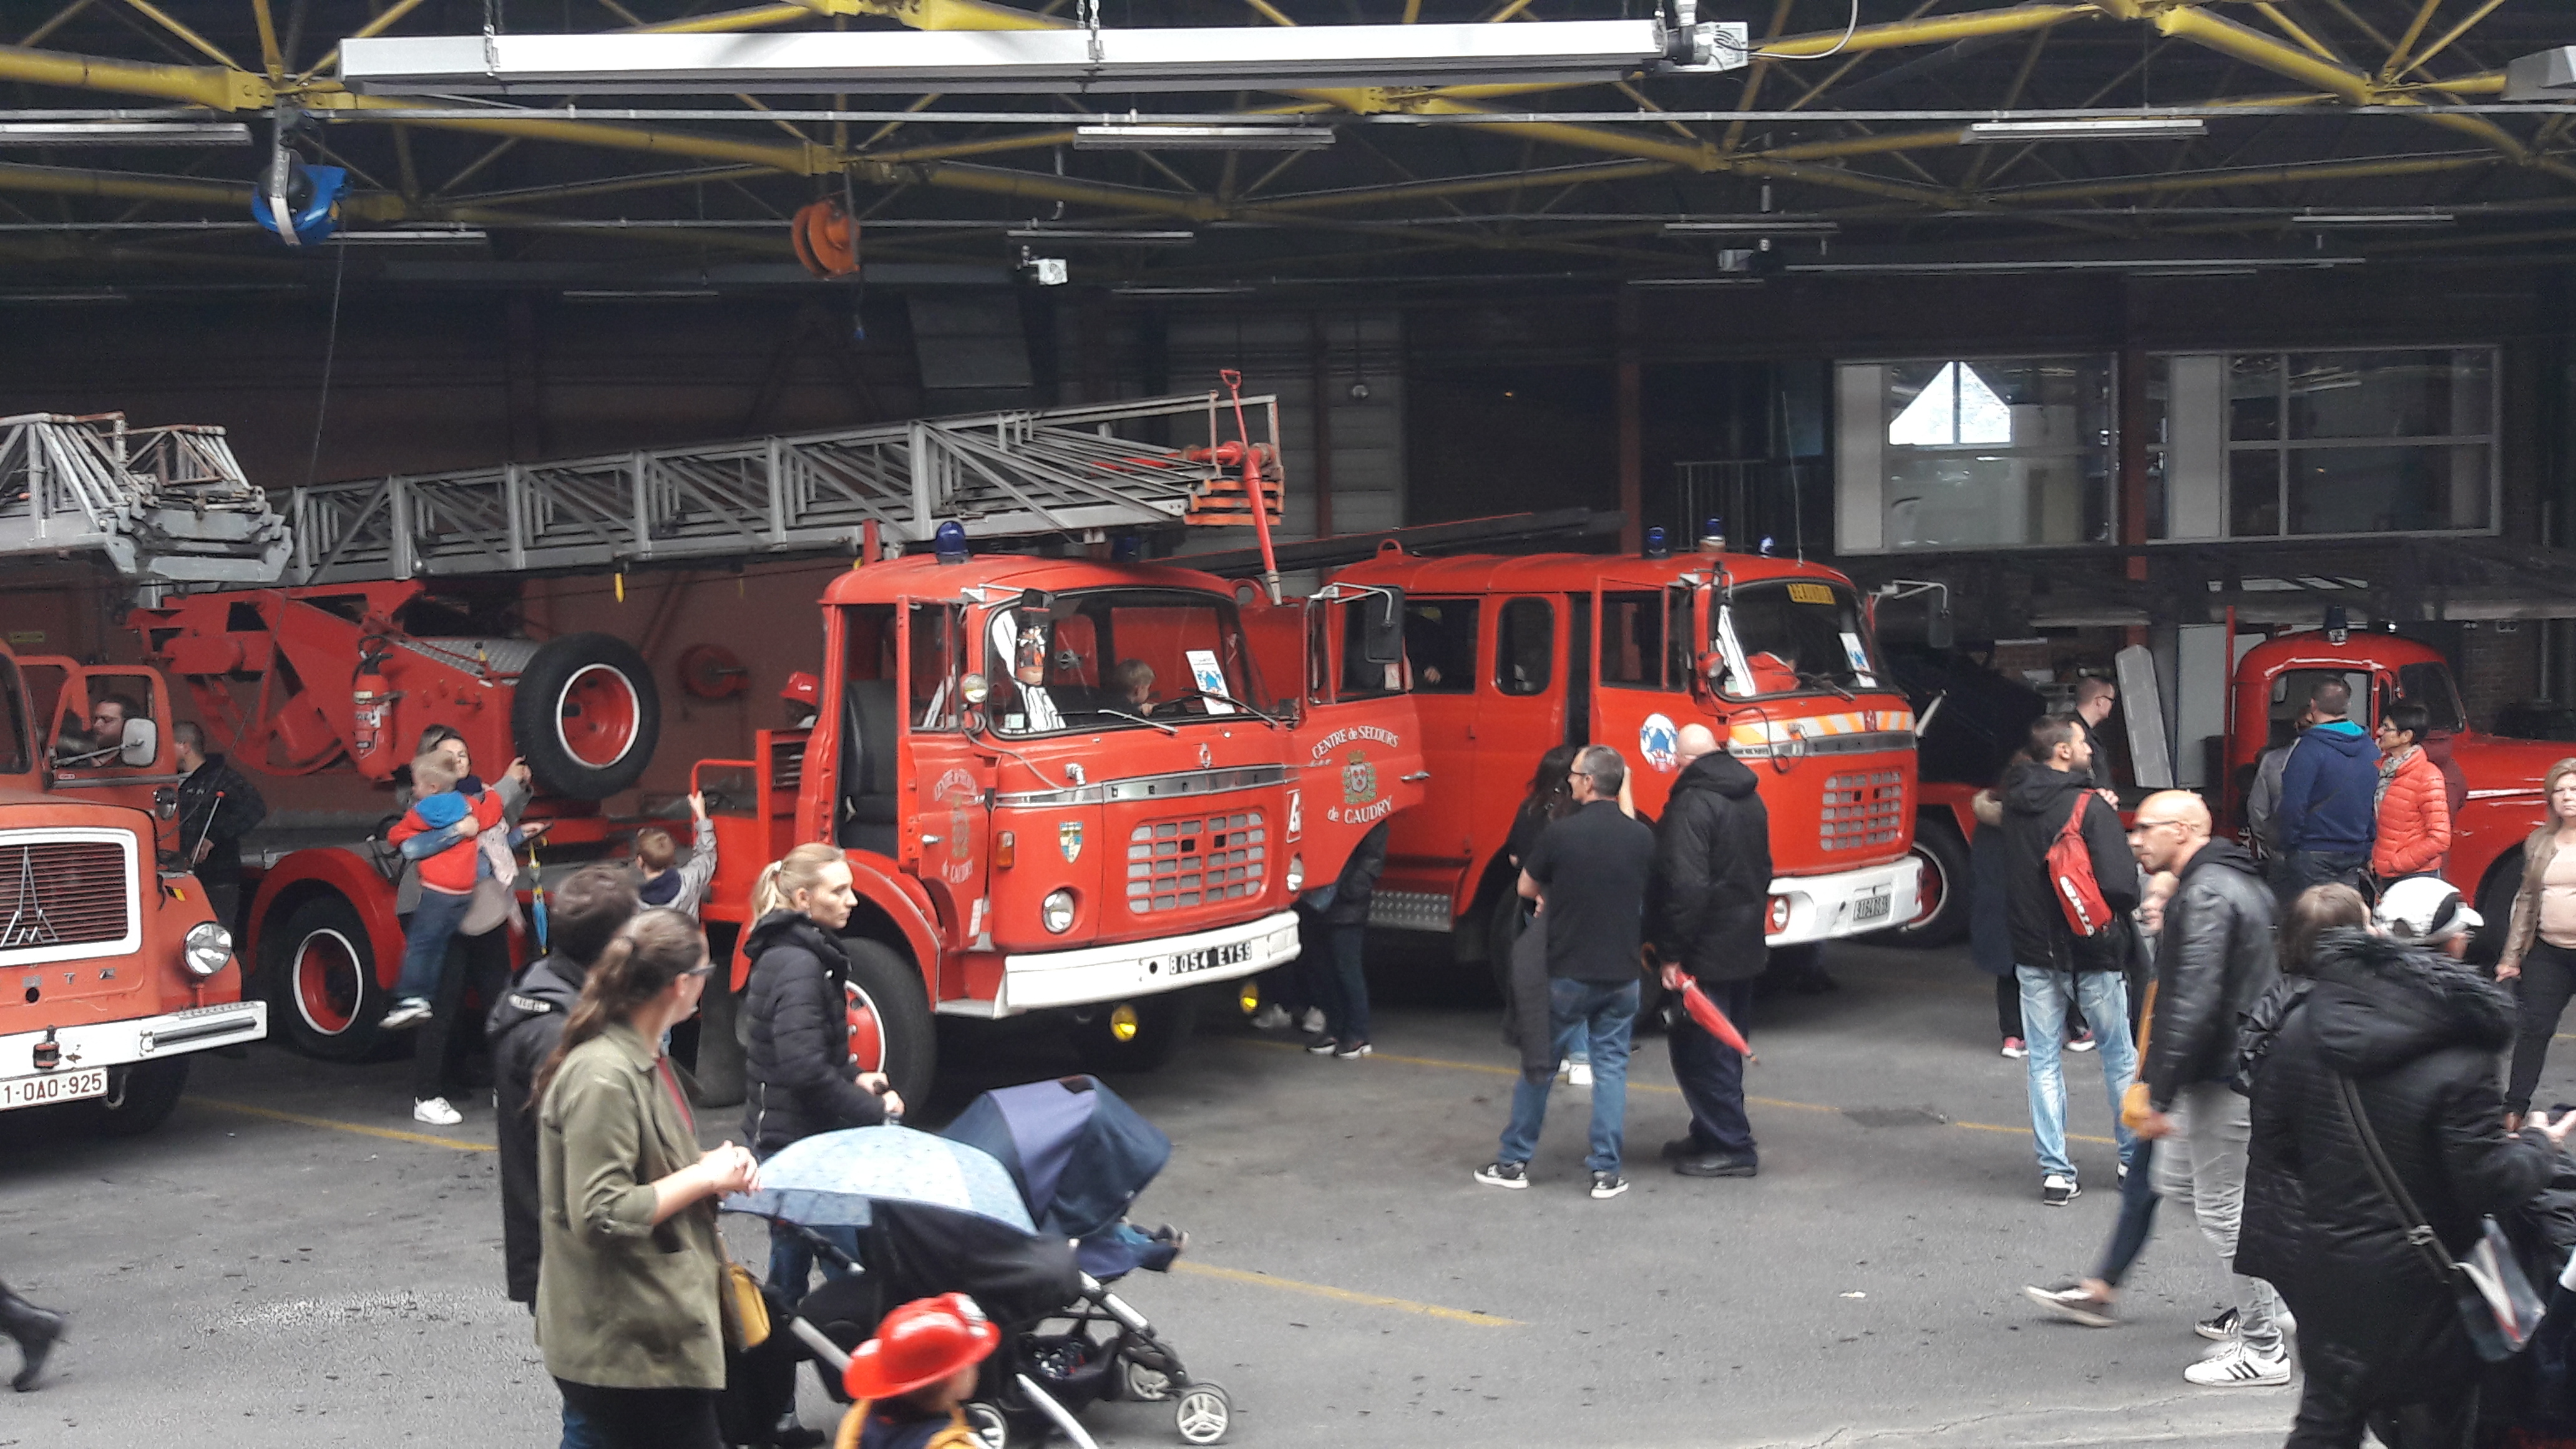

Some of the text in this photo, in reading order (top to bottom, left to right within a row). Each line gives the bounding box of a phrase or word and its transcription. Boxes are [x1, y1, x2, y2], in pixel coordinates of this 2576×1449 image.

[1311, 728, 1347, 759] CENTRE
[1348, 727, 1359, 741] de
[1327, 806, 1339, 822] de
[1344, 794, 1392, 824] CAUDRY
[1169, 940, 1252, 974] 8054 EY59
[4, 1073, 102, 1104] 1-OAO-925
